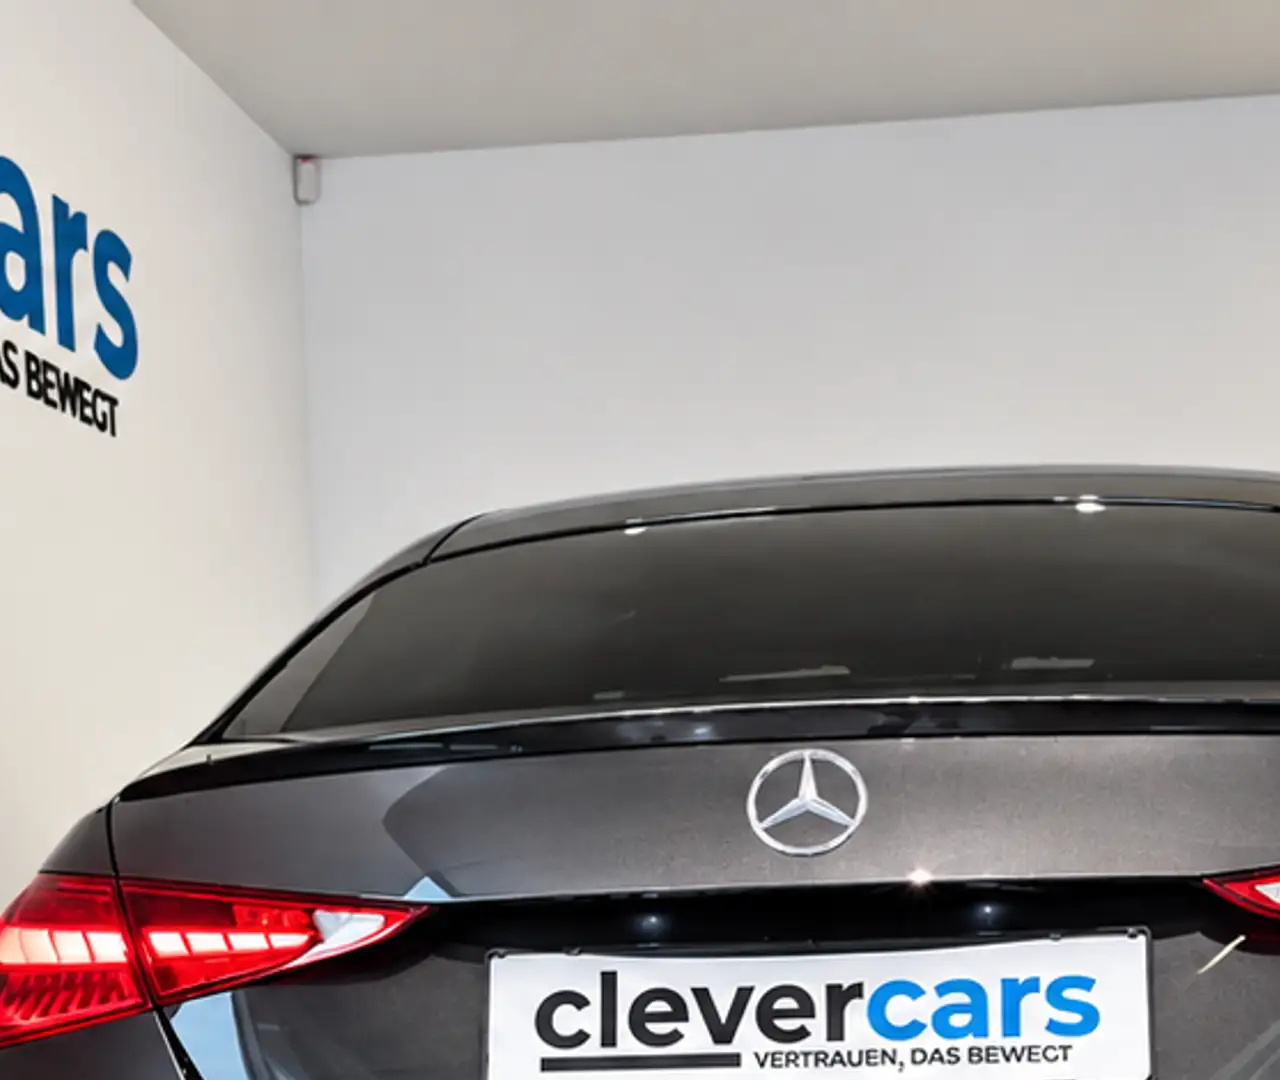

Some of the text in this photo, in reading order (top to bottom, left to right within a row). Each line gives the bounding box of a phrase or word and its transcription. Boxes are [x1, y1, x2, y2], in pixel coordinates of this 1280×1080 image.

[24, 349, 119, 437] BEWEGT
[534, 970, 1101, 1049] clevercars
[753, 1048, 905, 1073] VERTRAUEN,
[911, 1046, 961, 1066] DAS
